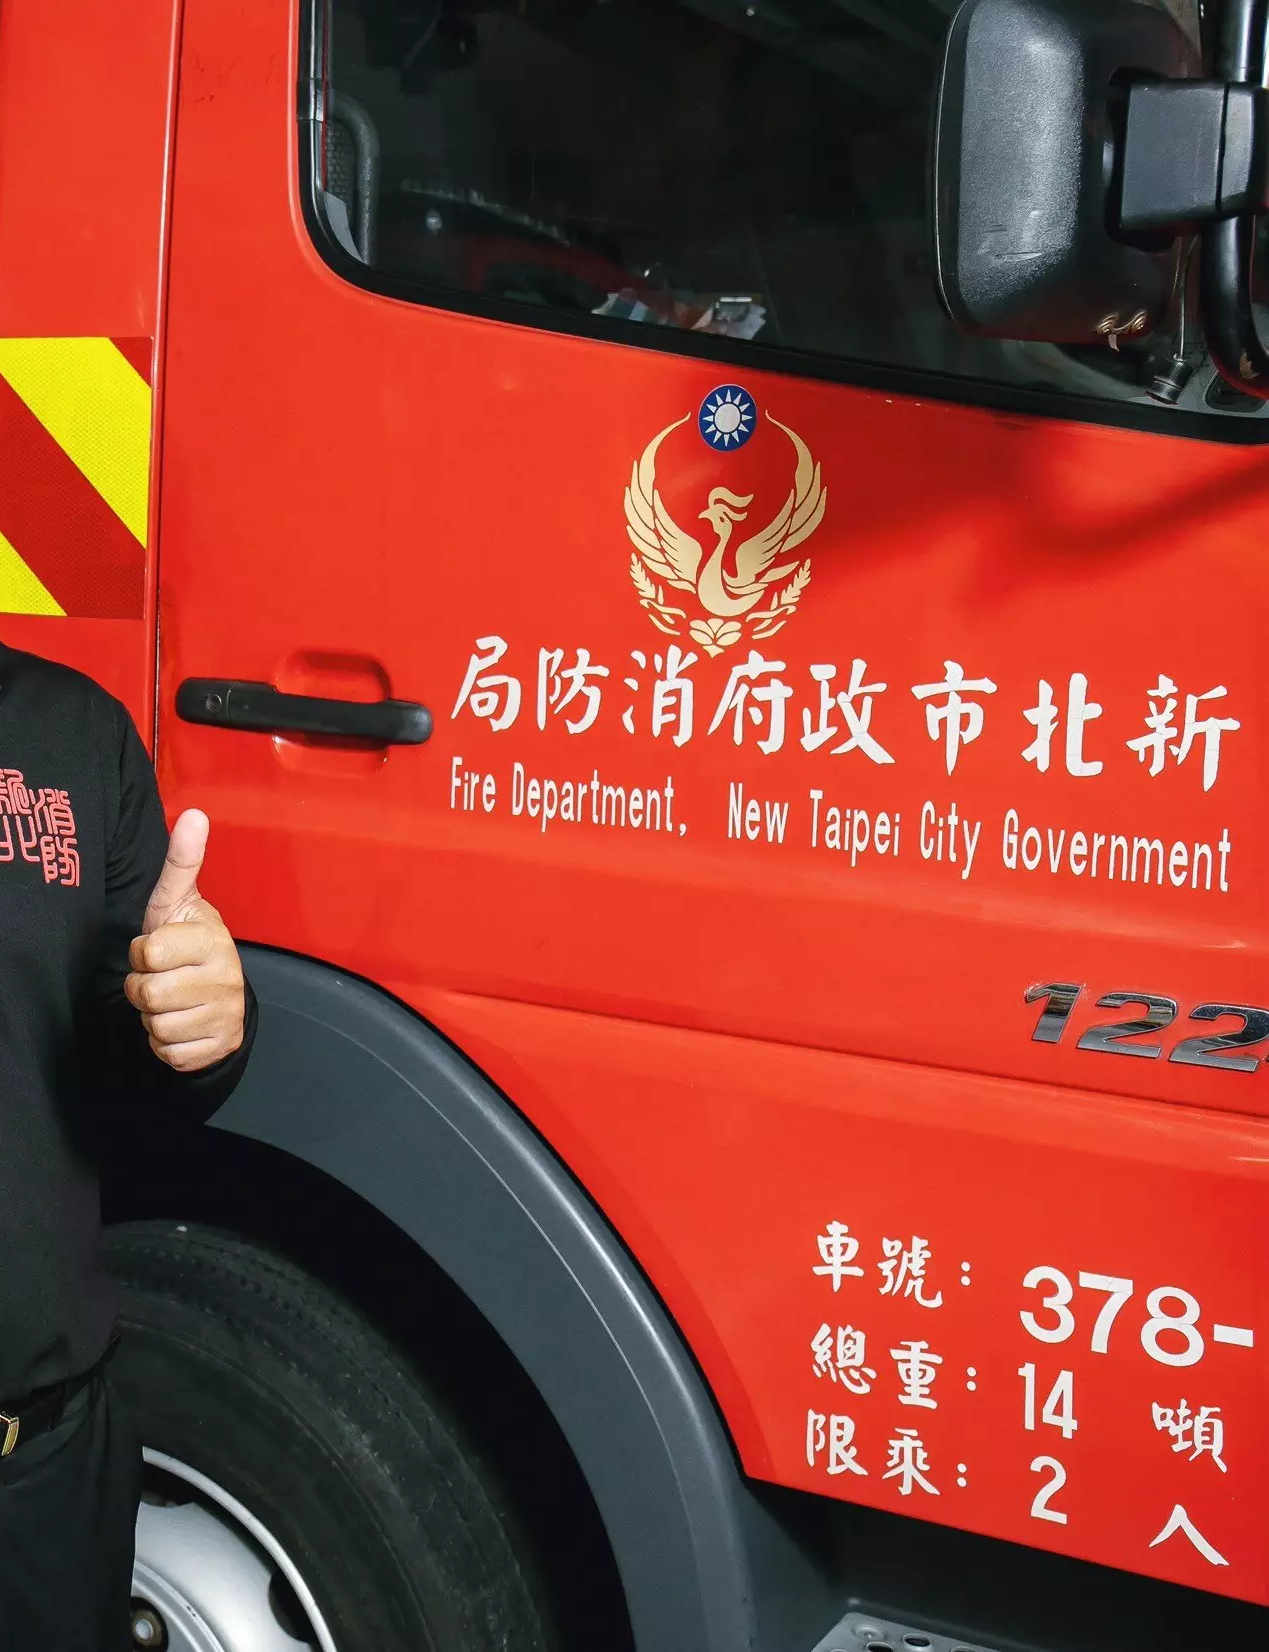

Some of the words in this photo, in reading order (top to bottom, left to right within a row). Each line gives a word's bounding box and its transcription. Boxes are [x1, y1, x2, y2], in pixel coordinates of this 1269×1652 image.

[450, 756, 497, 813] Fire
[511, 762, 688, 838] Department,
[727, 781, 790, 845] New
[809, 788, 901, 869] Taipei
[920, 800, 983, 881] City
[1002, 808, 1232, 893] Government
[1024, 982, 1269, 1073] 122
[1019, 1265, 1255, 1368] 378-
[1017, 1362, 1079, 1440] 14
[1151, 1398, 1228, 1474] 噸
[1029, 1455, 1068, 1526] 2
[1148, 1503, 1231, 1567] 人
